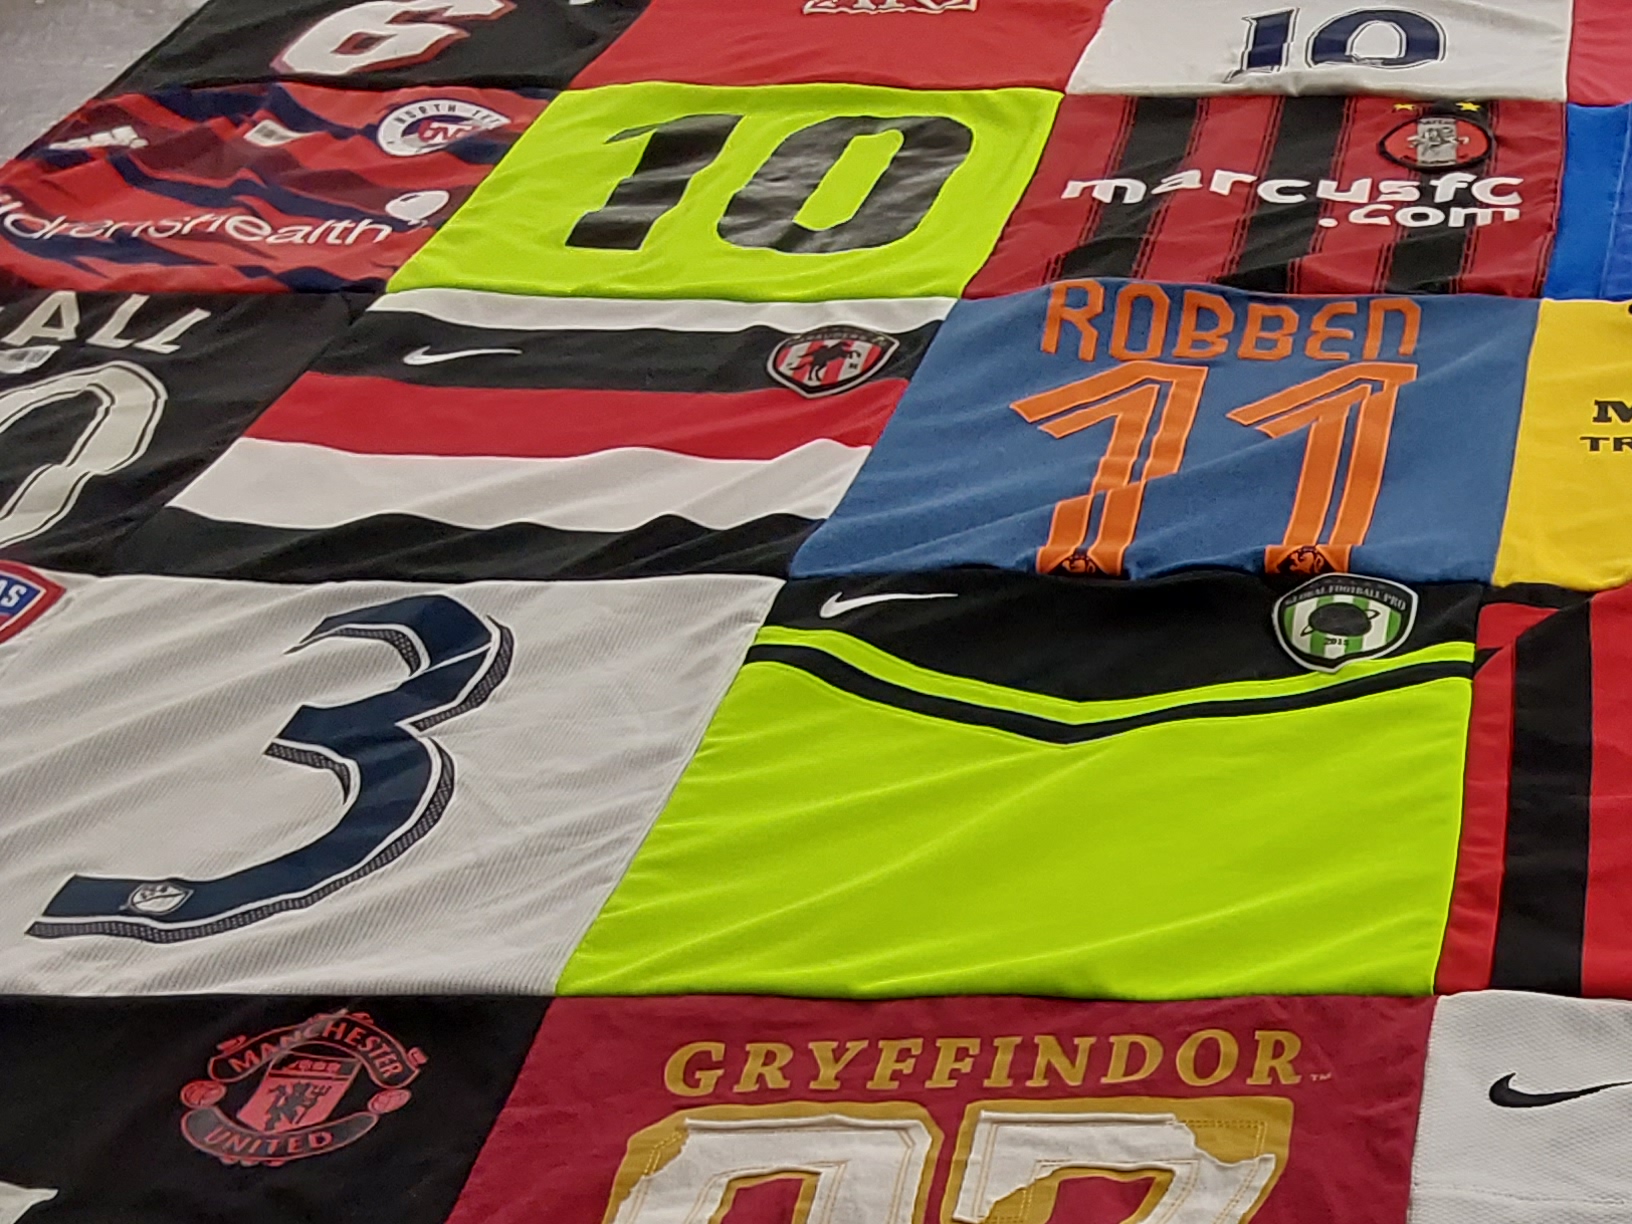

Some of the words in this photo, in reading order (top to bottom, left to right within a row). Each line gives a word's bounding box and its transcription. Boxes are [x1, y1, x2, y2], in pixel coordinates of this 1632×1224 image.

[1223, 7, 1448, 83] 10
[565, 113, 975, 254] 10
[1062, 170, 1523, 205] marcusfc
[1318, 203, 1520, 228] .com
[0, 290, 211, 353] ALL
[1041, 279, 1422, 362] ROBBEN
[1010, 361, 1418, 575] 11
[26, 593, 515, 944] 3
[227, 1021, 404, 1080] MANCHESTER
[664, 1029, 1302, 1097] GRYFFINDOR
[204, 1125, 334, 1155] UNITED
